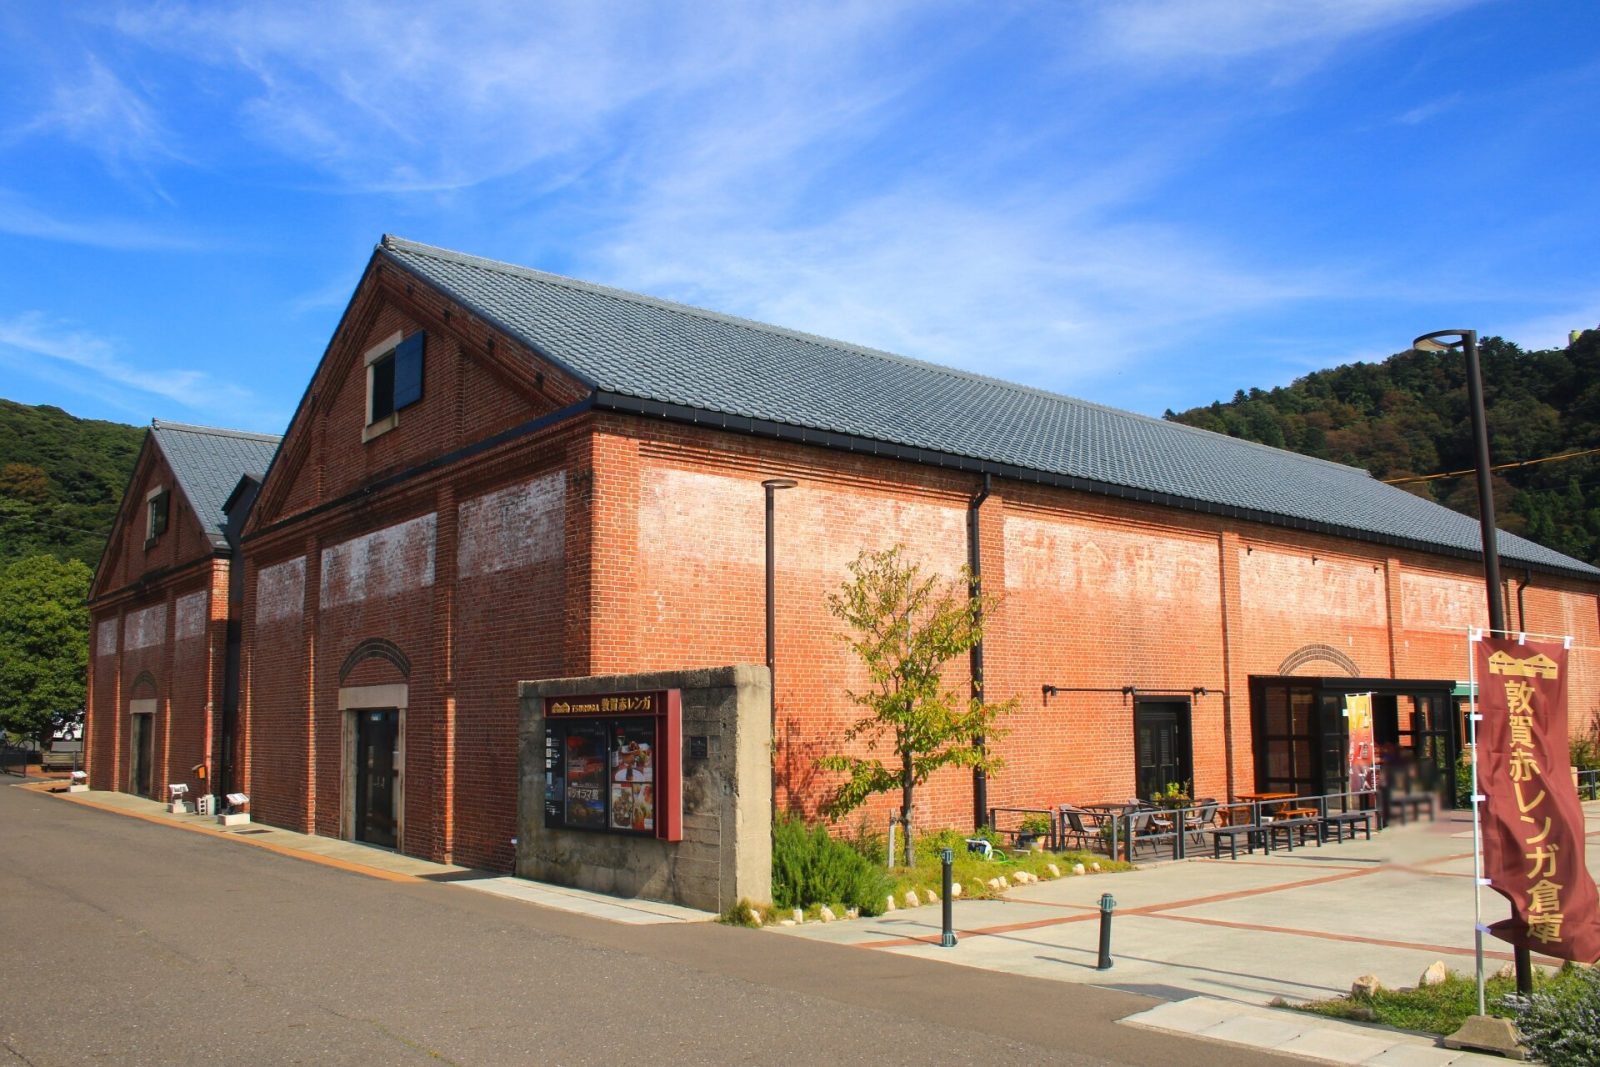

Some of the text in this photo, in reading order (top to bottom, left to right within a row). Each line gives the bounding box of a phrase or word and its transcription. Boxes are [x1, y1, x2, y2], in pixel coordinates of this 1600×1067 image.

[601, 696, 651, 711] 敦賀赤レンガ
[1504, 680, 1564, 943] 敦賀赤レンガ倉庫
